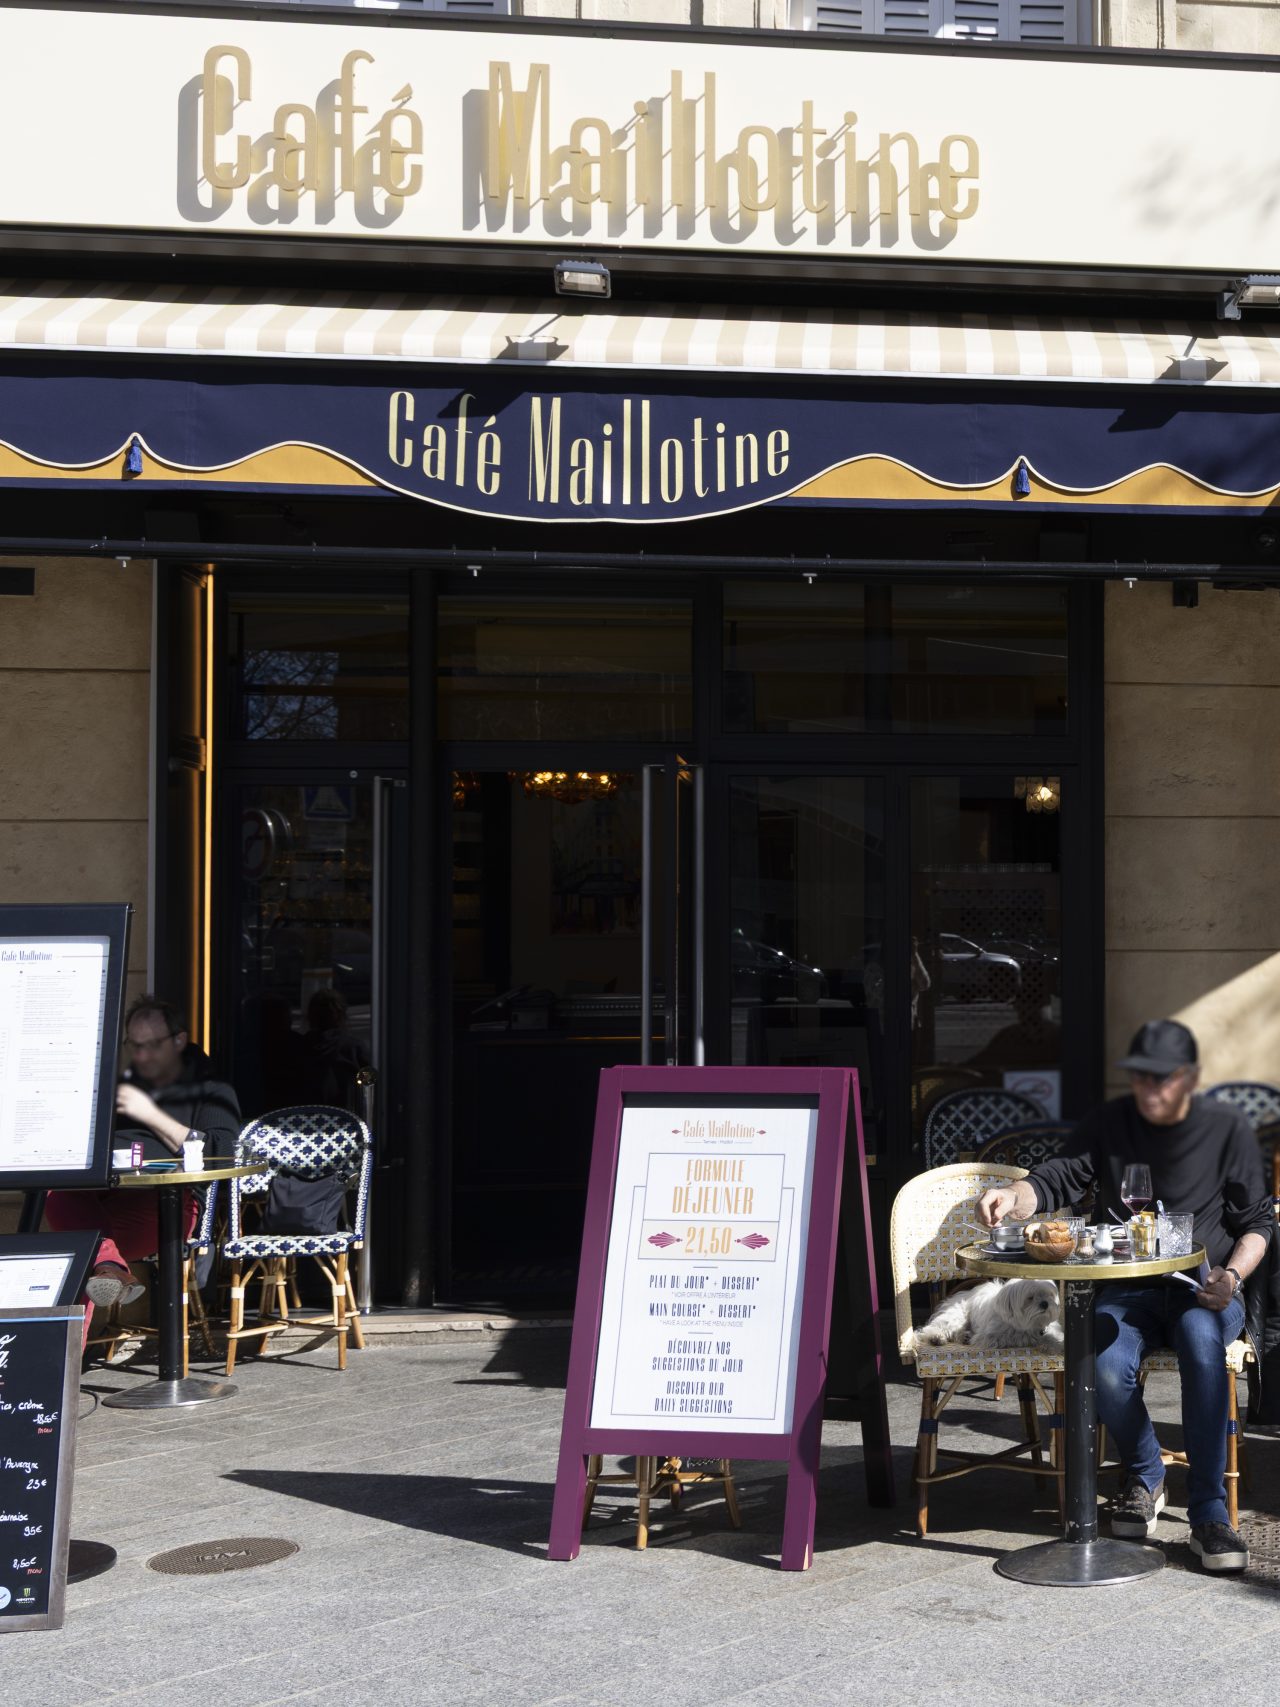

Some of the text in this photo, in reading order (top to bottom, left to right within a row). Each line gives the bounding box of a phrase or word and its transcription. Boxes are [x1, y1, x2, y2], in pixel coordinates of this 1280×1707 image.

[202, 44, 980, 221] Café Maillotine
[388, 390, 790, 506] Café Maillotine
[683, 1119, 755, 1138] Café Maillotine
[686, 1159, 745, 1182] FORMULE
[672, 1182, 754, 1215] DÉJEUNER
[684, 1226, 732, 1257] 21,50
[649, 1274, 667, 1288] PLAT
[670, 1275, 681, 1288] DU
[649, 1303, 668, 1316] MAIN
[667, 1338, 731, 1355] DÉCOUVREZ NOS
[652, 1356, 743, 1372] SUGGESTIONS DU JOUR
[666, 1380, 724, 1396] DISCOVER OUR
[654, 1397, 733, 1414] DAILY SUGGESTIONS
